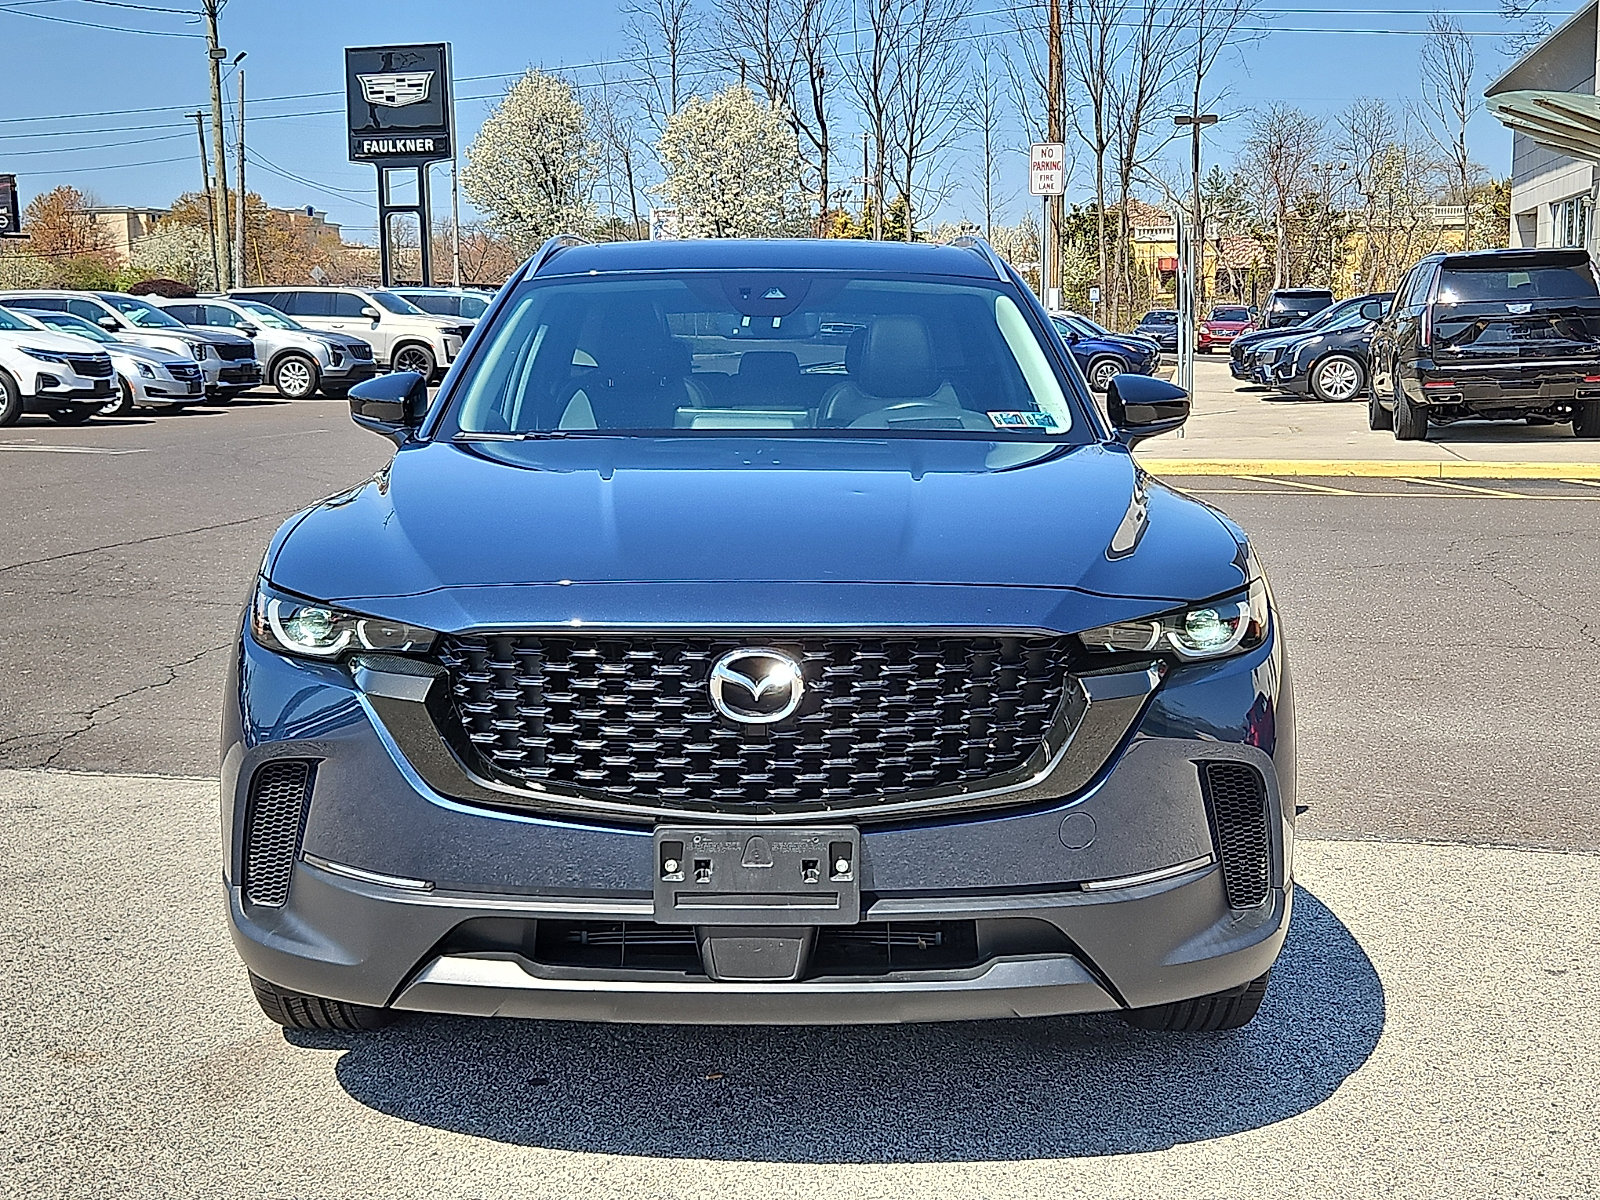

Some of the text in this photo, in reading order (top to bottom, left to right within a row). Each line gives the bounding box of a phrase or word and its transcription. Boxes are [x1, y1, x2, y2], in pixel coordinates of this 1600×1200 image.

[363, 138, 434, 153] FAULKNER
[1041, 148, 1053, 158] NO
[1033, 161, 1062, 171] PARKING
